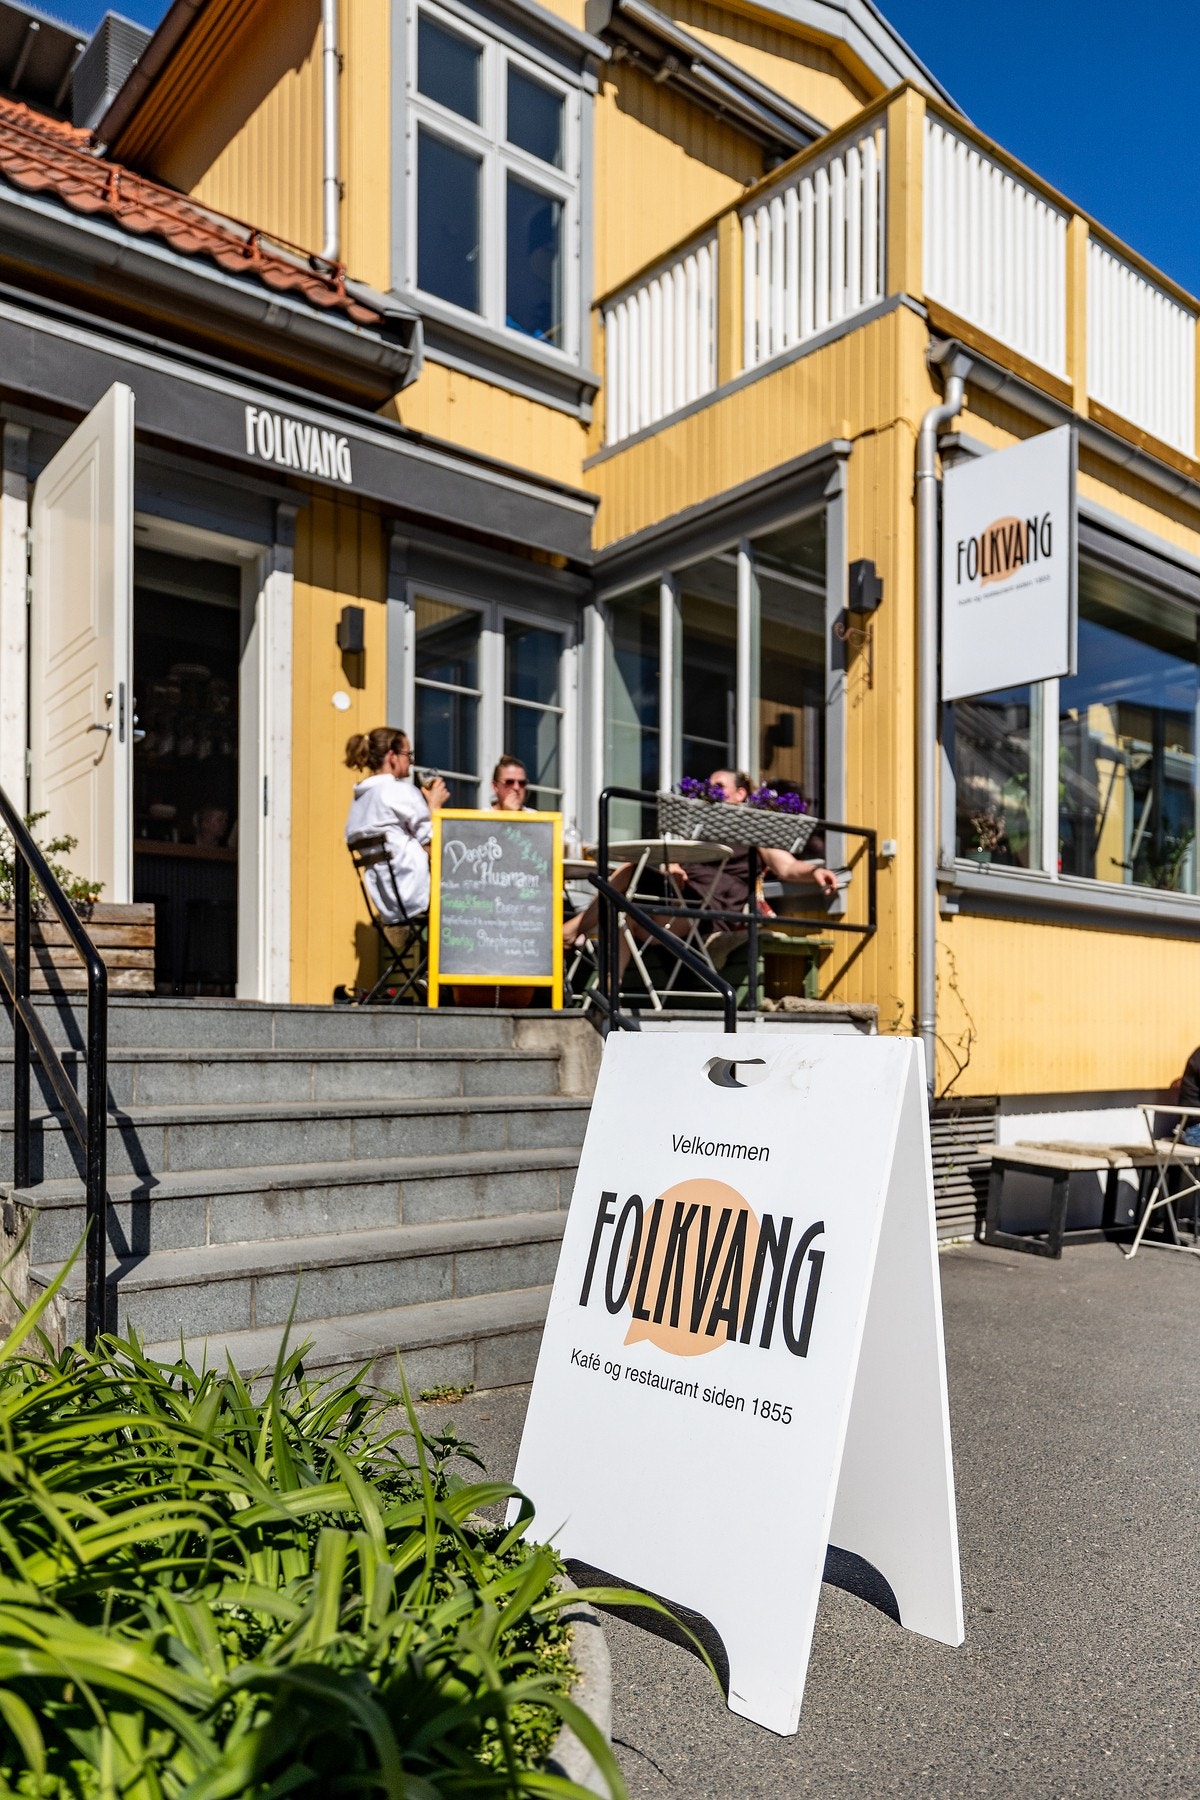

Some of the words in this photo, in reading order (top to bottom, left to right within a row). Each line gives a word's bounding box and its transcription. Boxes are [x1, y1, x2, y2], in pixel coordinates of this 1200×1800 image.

[245, 405, 353, 485] FOLKVANG
[956, 511, 1052, 585] FOLKVANG
[671, 1134, 770, 1161] Velkommen
[579, 1190, 826, 1358] FOLKVANG
[570, 1348, 601, 1371] Kafé
[604, 1361, 622, 1380] og
[624, 1366, 699, 1399] restaurant
[702, 1386, 746, 1412] siden
[752, 1398, 793, 1425] 1855
